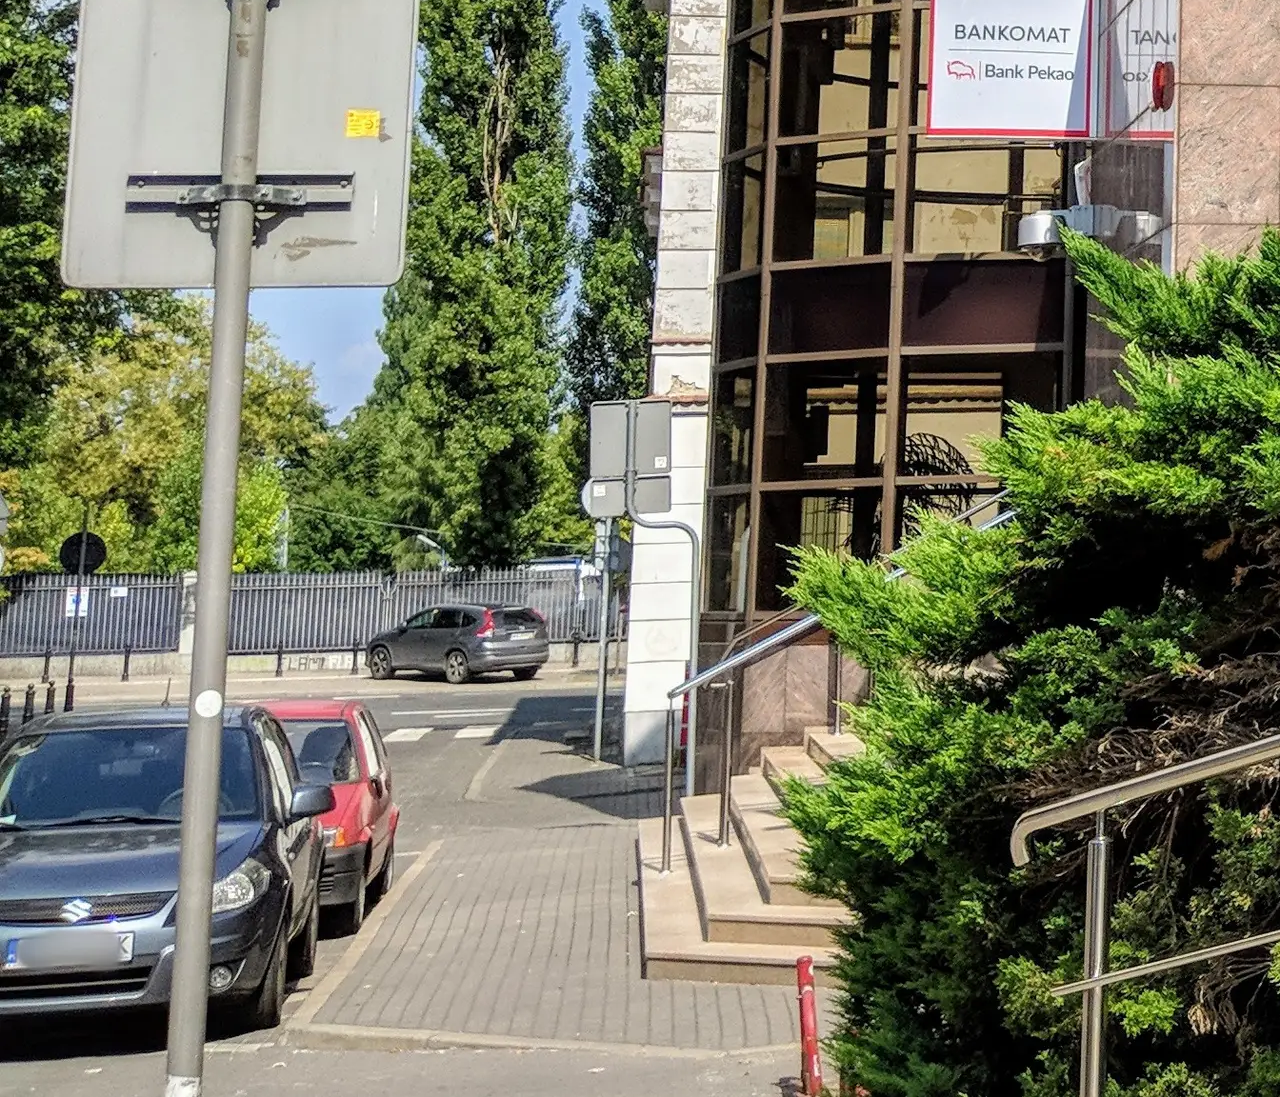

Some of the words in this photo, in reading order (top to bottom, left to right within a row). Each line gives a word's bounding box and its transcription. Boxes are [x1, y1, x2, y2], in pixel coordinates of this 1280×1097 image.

[955, 24, 1071, 43] BANKOMAT
[985, 64, 1024, 79] Bank
[1028, 65, 1074, 81] Pekao
